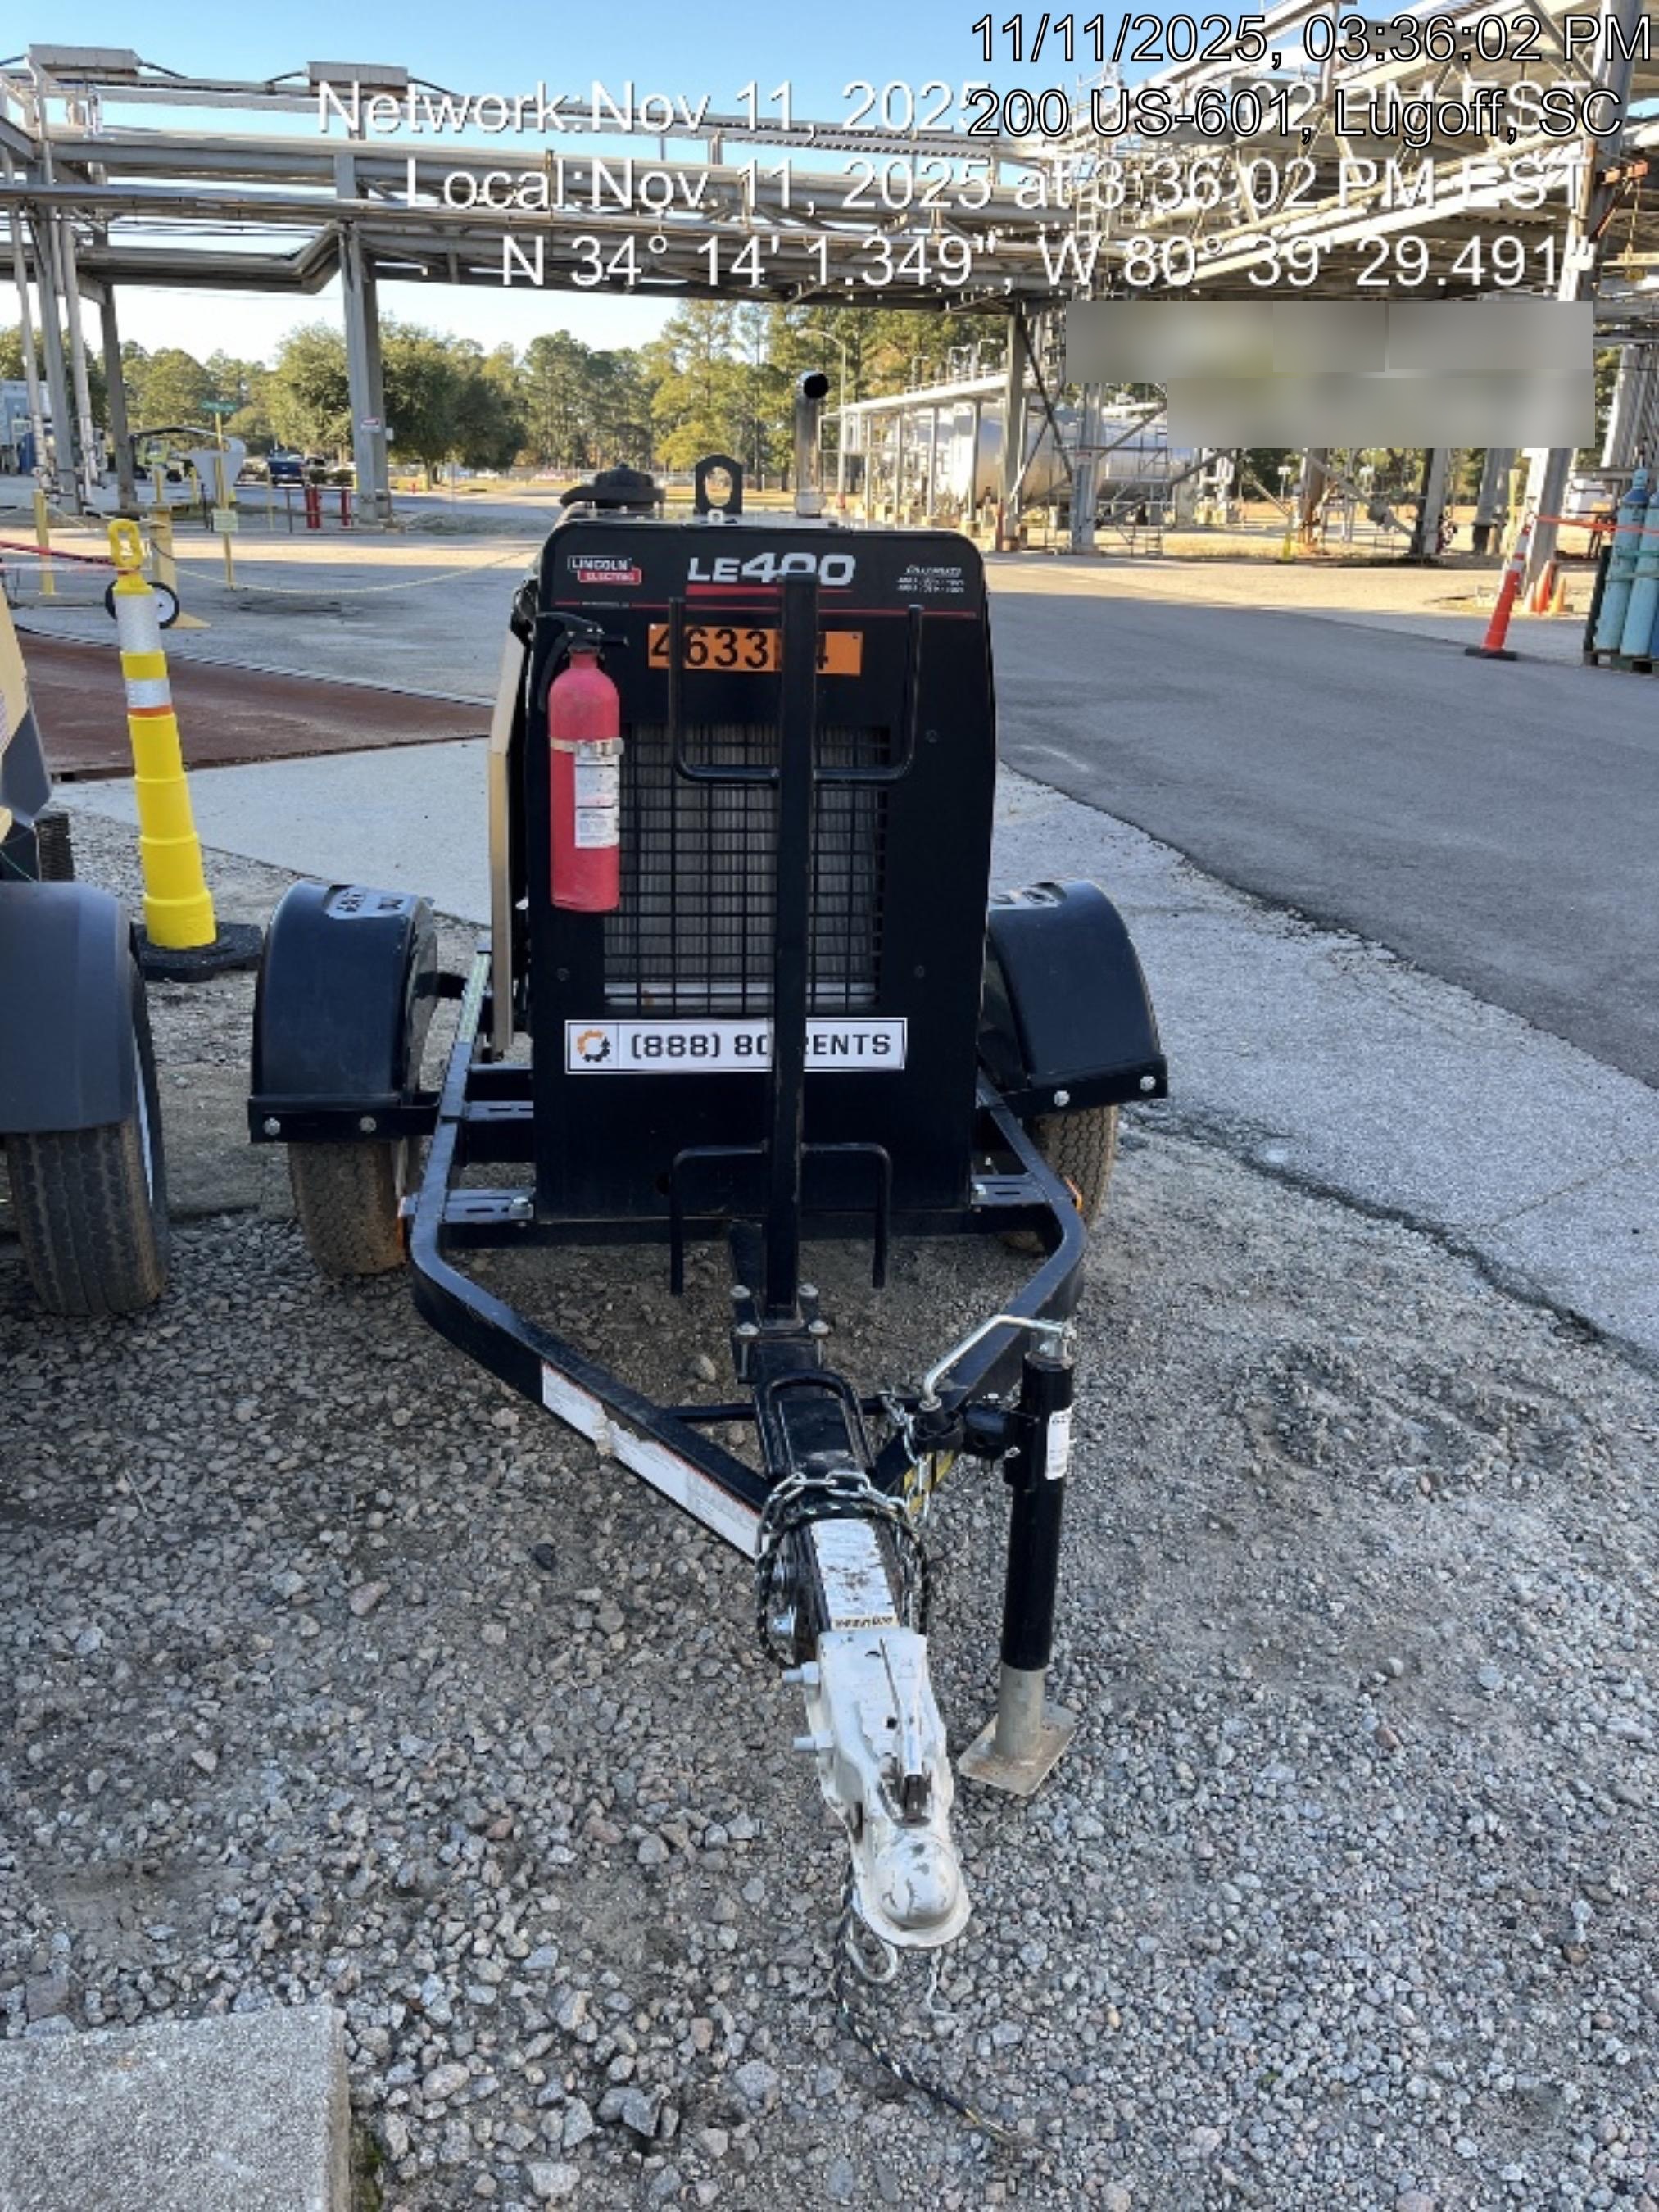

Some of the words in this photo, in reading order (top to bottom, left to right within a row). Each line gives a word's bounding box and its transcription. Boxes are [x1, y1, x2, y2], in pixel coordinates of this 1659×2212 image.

[572, 558, 628, 571] LINCOLN
[687, 552, 856, 586] LE400
[651, 626, 829, 670] 46334
